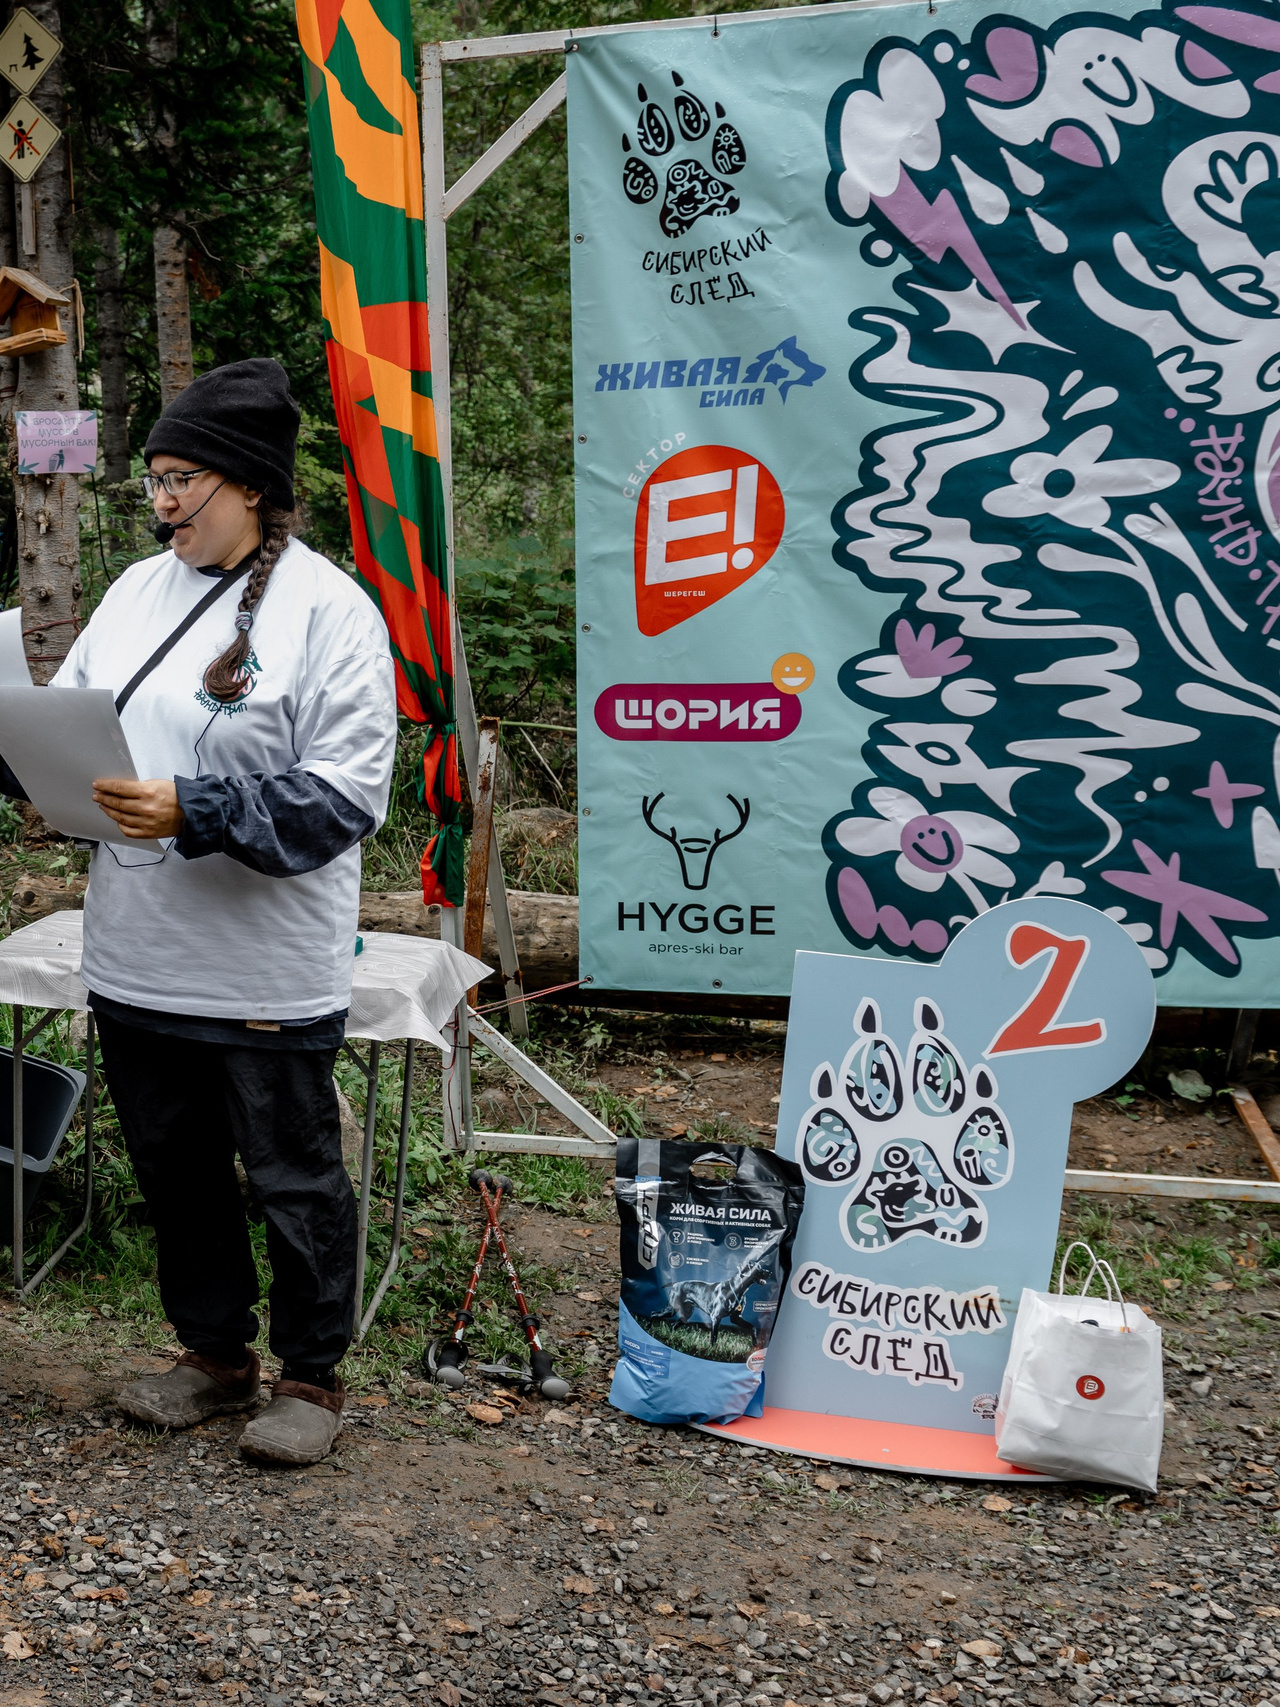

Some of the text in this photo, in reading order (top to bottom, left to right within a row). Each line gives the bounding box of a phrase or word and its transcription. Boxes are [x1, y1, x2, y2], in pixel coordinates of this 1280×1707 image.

[642, 227, 773, 275] СИБИРСКИЙ
[670, 271, 755, 306] СЛЁД
[594, 355, 742, 392] ЖИВАЯ
[698, 387, 765, 408] СИЛА
[20, 437, 75, 448] МУСОРНЫЙ
[72, 428, 79, 436] В
[622, 431, 687, 499] СЕКТОР
[664, 590, 706, 598] ШЕРЕГЕШ
[614, 698, 781, 730] ШОРИЯ
[617, 901, 776, 936] HYGGE
[648, 942, 744, 956] apres-ski bar
[986, 921, 1105, 1058] 2
[669, 1202, 772, 1221] ЖИВАЯ СИЛА
[798, 1268, 1001, 1331] СИБИРСКИЙ
[830, 1327, 958, 1387] СЛЁД
